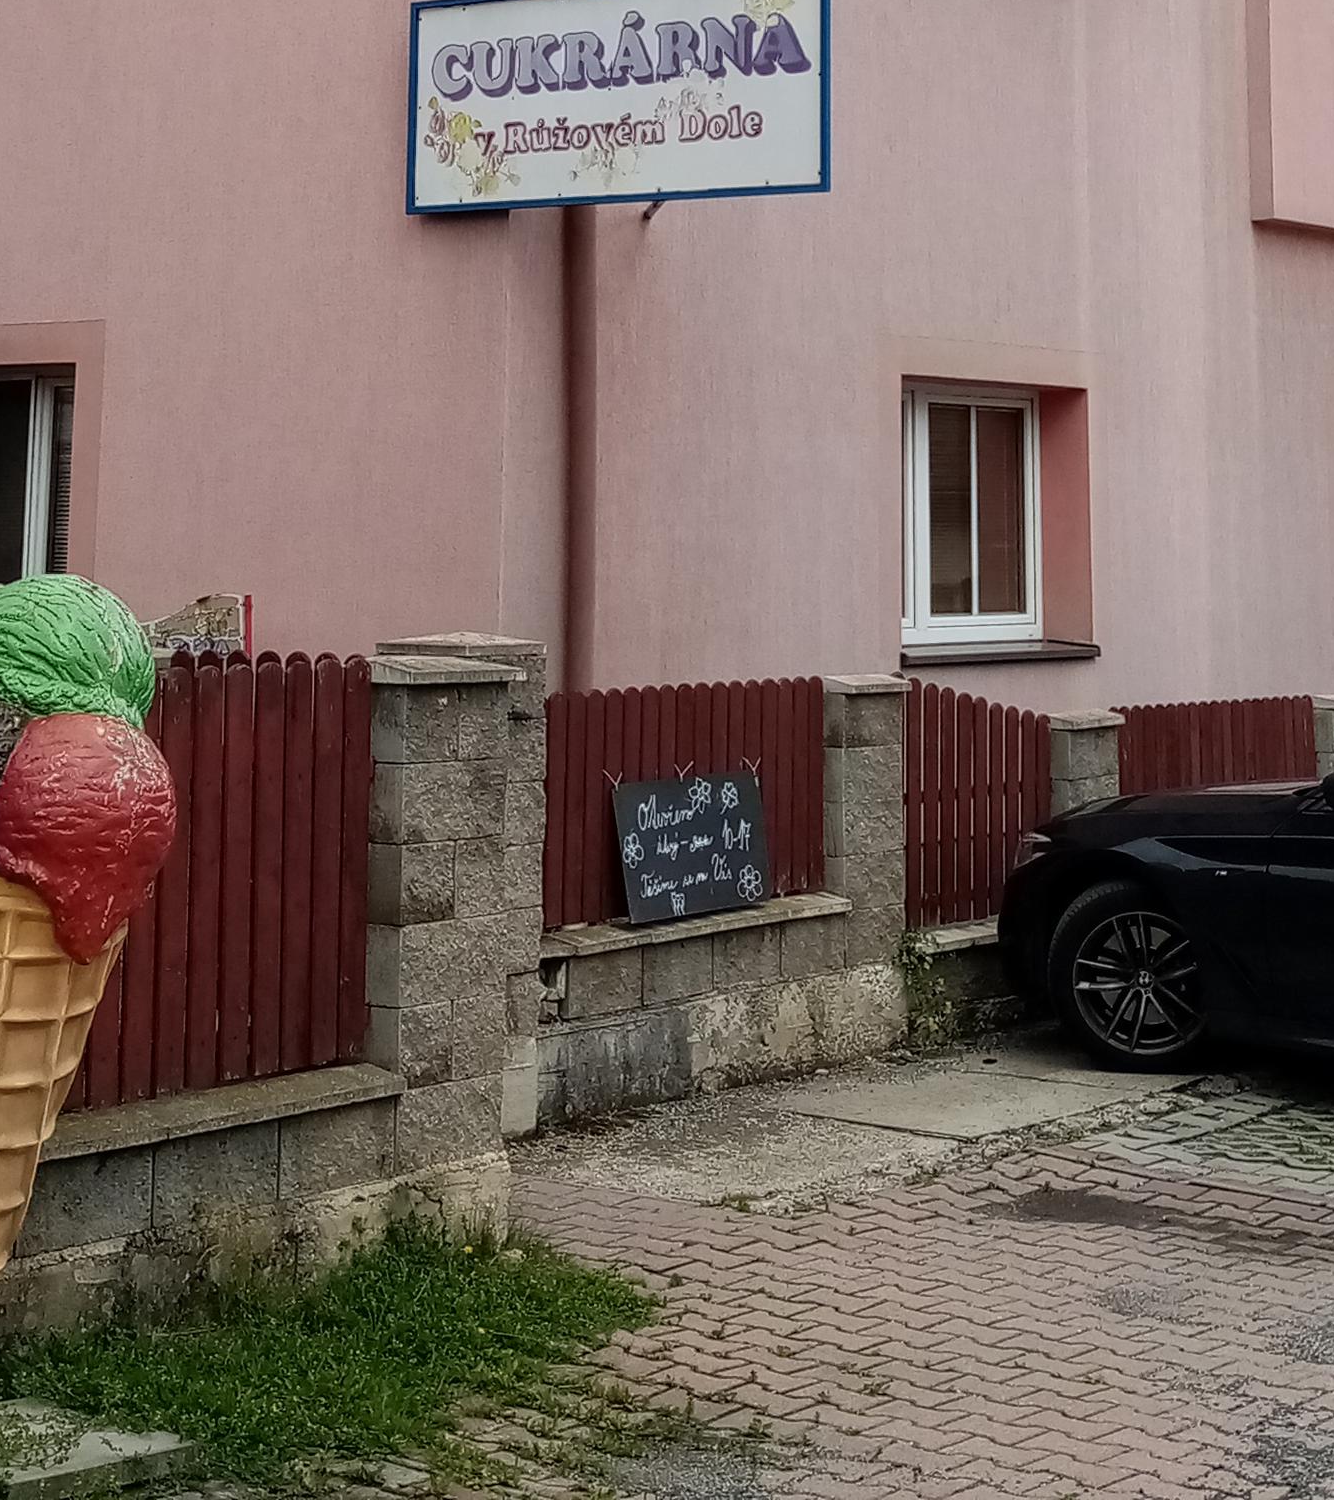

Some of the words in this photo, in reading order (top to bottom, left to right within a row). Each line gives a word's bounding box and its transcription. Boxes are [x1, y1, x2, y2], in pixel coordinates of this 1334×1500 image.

[431, 10, 812, 101] CUKRÁRNA
[503, 112, 666, 155] Růžovém
[678, 105, 764, 143] Dole
